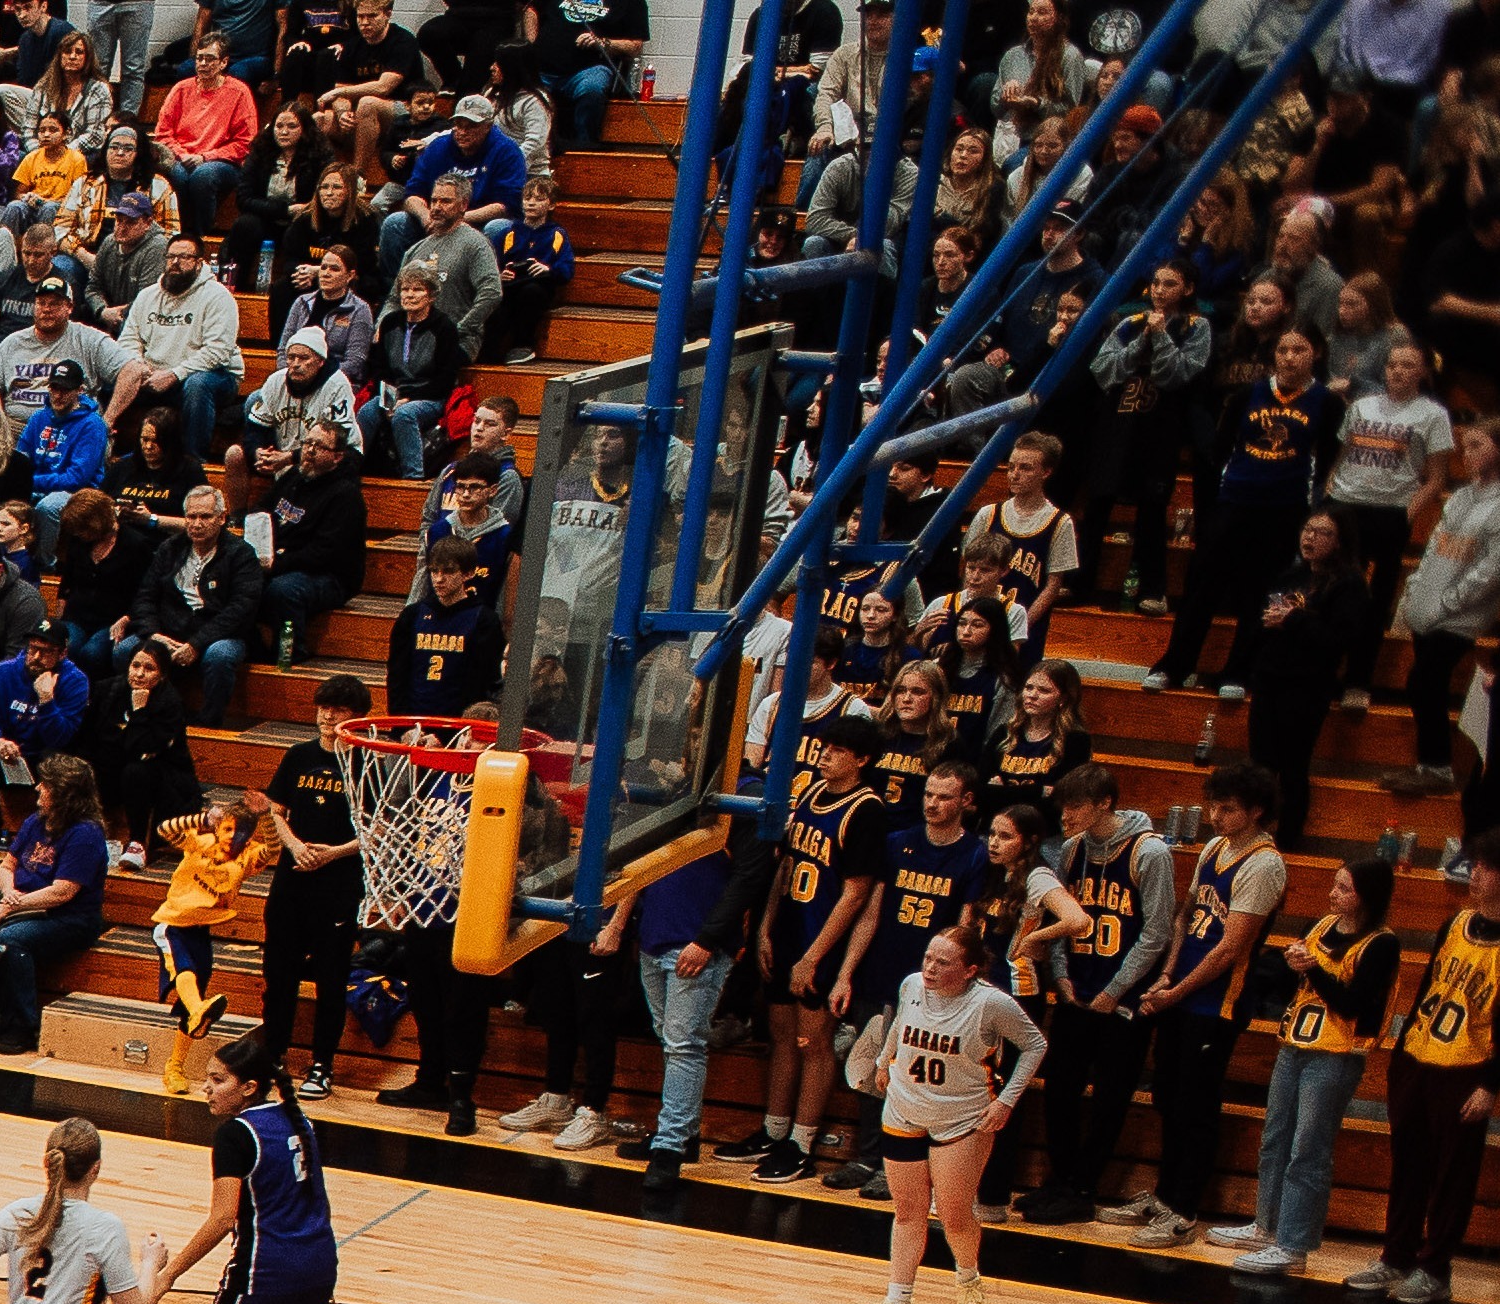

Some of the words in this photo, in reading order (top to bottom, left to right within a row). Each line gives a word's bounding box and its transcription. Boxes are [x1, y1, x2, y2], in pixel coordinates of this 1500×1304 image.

[1, 298, 34, 317] VIKIN
[557, 505, 624, 533] BARA
[1009, 547, 1043, 589] AGA
[428, 654, 444, 681] 2
[298, 774, 346, 795] BARAG
[884, 776, 906, 804] 5
[897, 896, 935, 929] 52
[902, 1024, 961, 1056] BARAGA
[908, 1056, 947, 1087] 40
